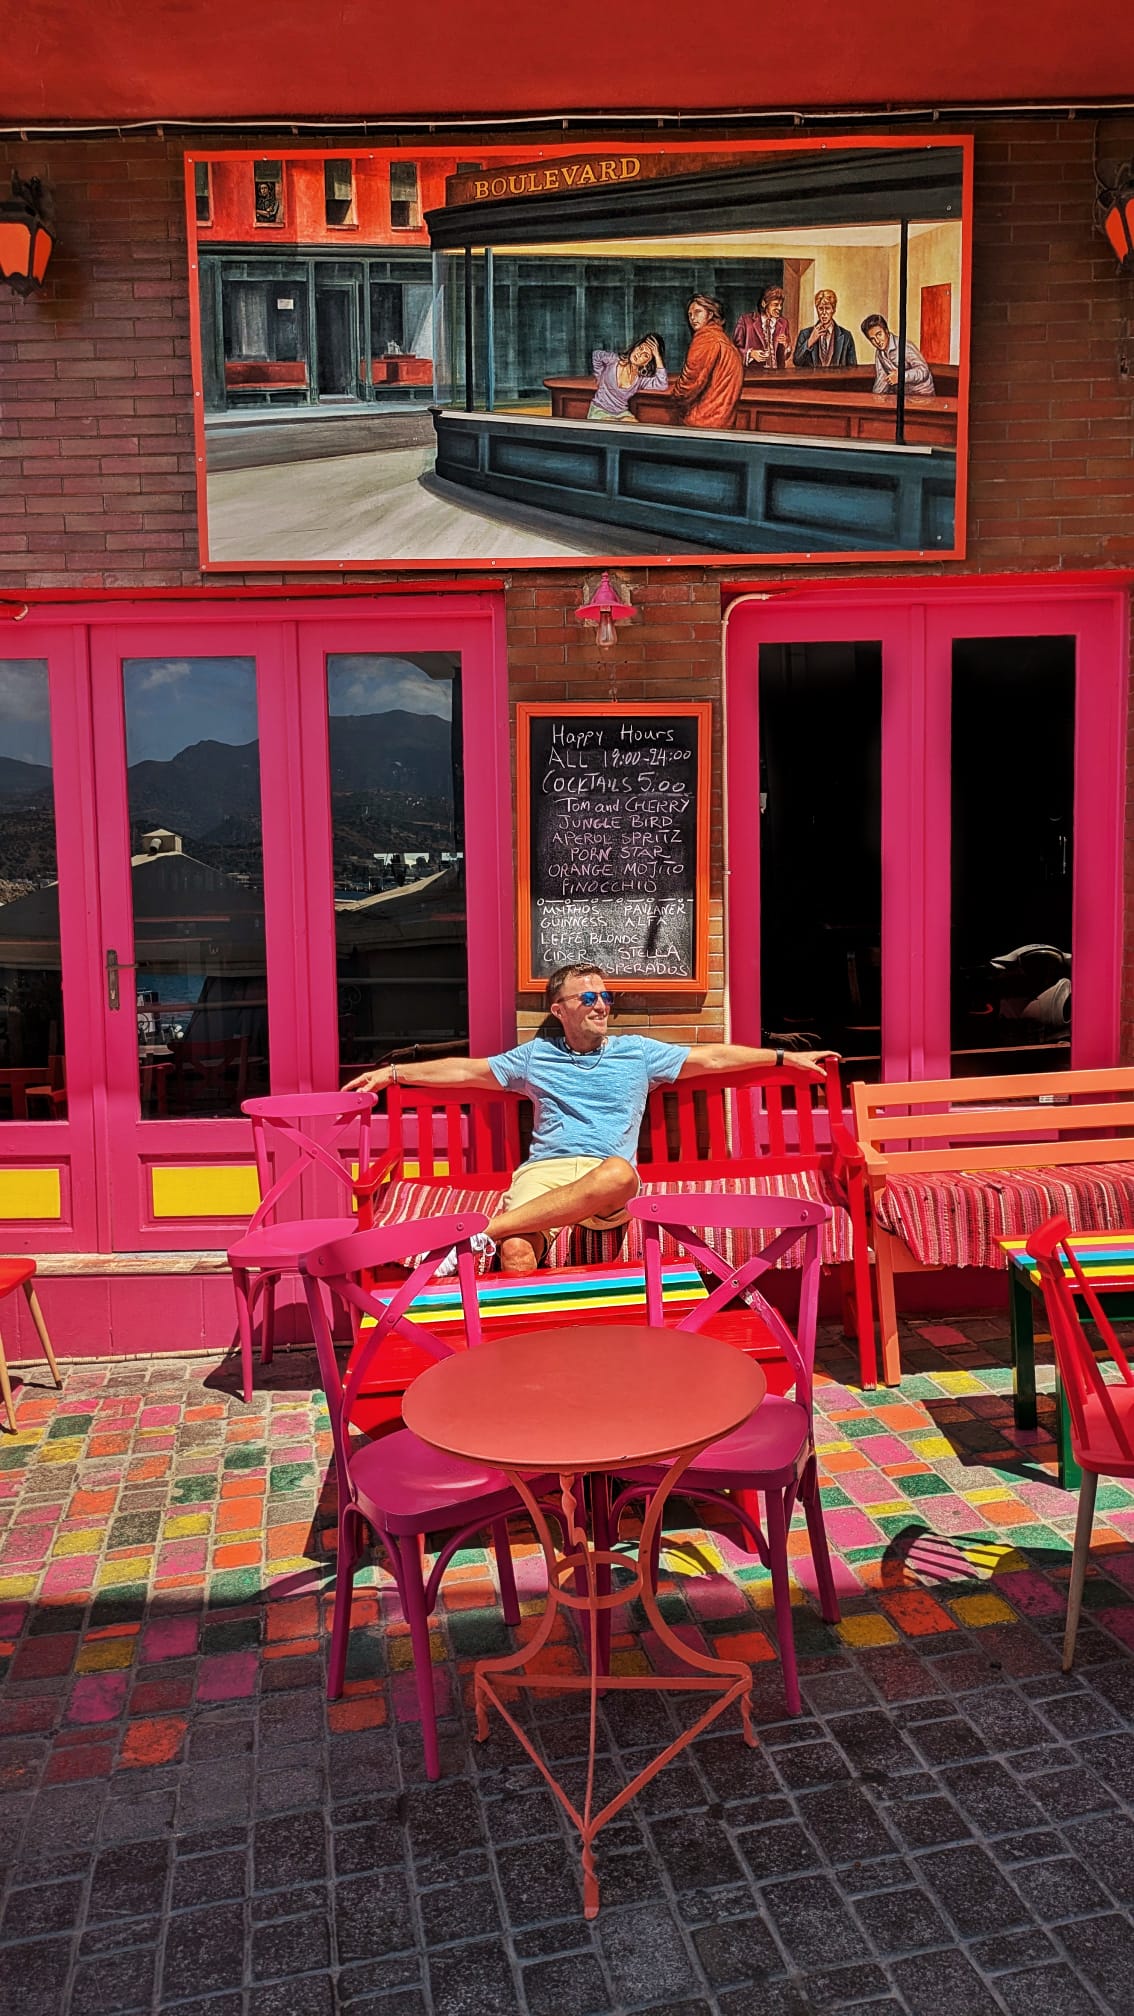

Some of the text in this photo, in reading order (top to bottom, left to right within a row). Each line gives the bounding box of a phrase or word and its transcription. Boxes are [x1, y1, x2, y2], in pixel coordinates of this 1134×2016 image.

[474, 157, 641, 199] BOULEVARD
[552, 723, 675, 749] Happy Hours
[548, 746, 588, 769] ALL
[542, 769, 633, 795] COCKTAILS
[594, 798, 620, 812] and
[624, 796, 690, 814] CHERRY
[557, 814, 673, 829] JUNGLE BIRD
[552, 829, 683, 846] APEROL SPRITZ
[570, 845, 672, 862] PORN STAR
[548, 860, 684, 879] ORANGE MOJITO
[562, 878, 657, 896] PINOCCHIO
[542, 904, 600, 916] MYTHOS
[540, 915, 668, 929] GUINNESS ALFA
[541, 931, 639, 946] LEFFE BLONDE
[543, 944, 681, 962] CIDER STELLA
[598, 962, 689, 977] SPERADOS
